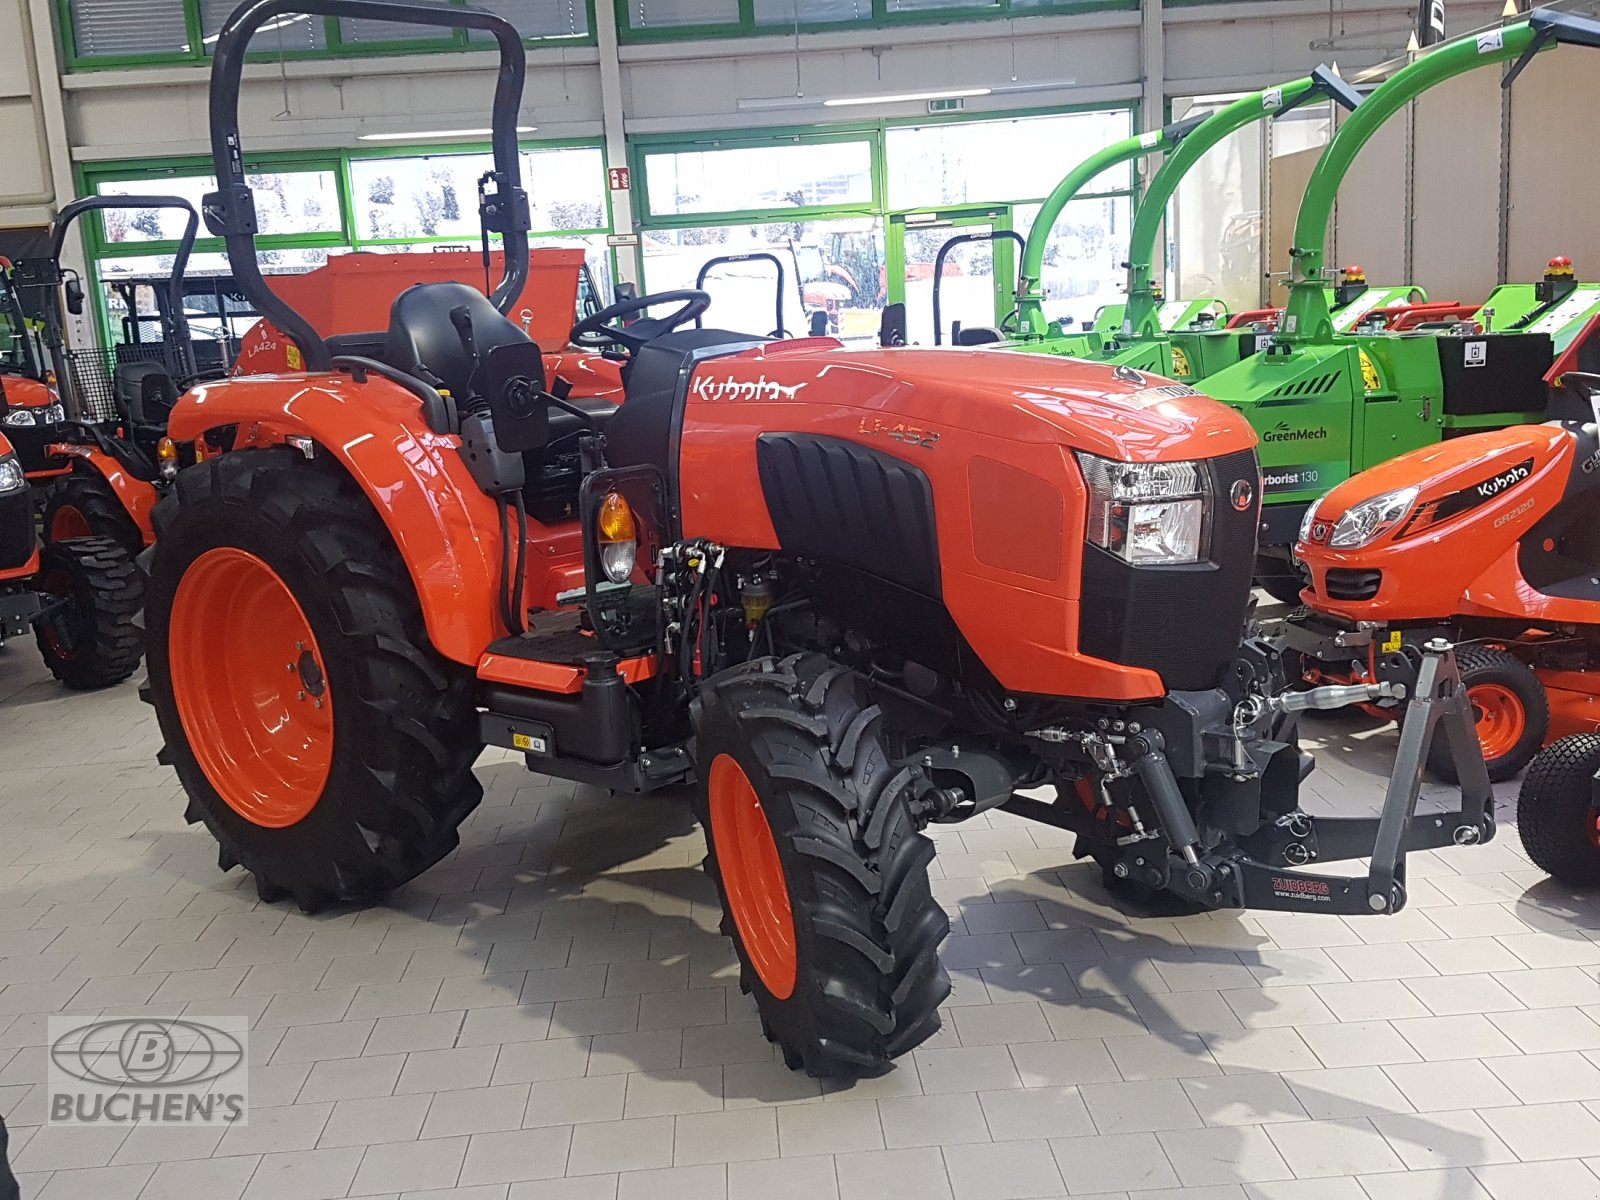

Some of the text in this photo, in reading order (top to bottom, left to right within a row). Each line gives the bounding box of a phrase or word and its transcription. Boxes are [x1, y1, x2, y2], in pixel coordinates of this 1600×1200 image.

[247, 341, 277, 358] LA424
[692, 375, 782, 401] Kubota
[1263, 426, 1327, 442] GreenMech
[1264, 471, 1318, 485] rborist 130
[1477, 467, 1529, 496] Kubota
[1271, 877, 1329, 895] ZUIDBERG
[1274, 890, 1331, 902] www.zuidberg.com
